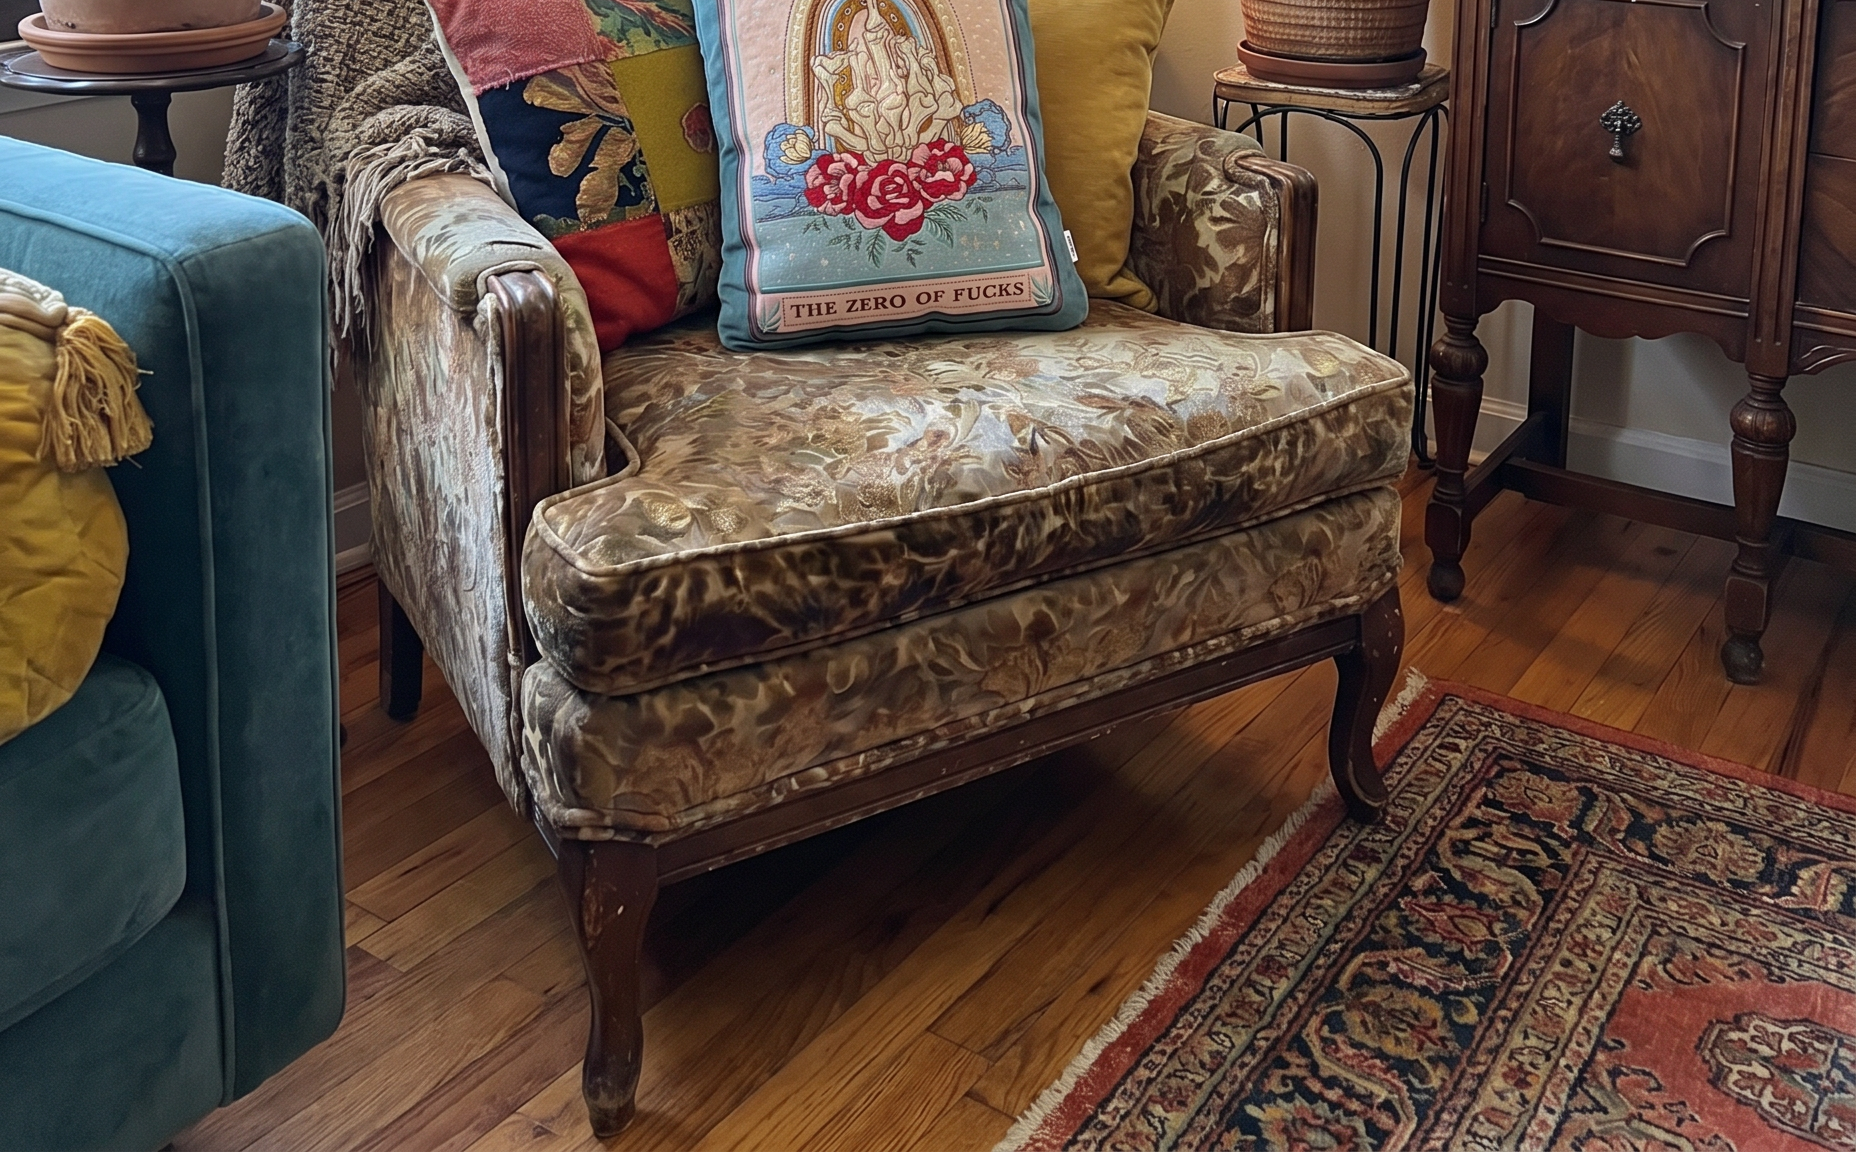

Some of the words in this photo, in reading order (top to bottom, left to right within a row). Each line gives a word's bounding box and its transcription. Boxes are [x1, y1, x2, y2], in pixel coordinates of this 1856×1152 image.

[790, 301, 837, 318] THE
[846, 294, 906, 313] ZERO
[915, 290, 945, 305] OF
[953, 282, 1024, 302] FUCKS
